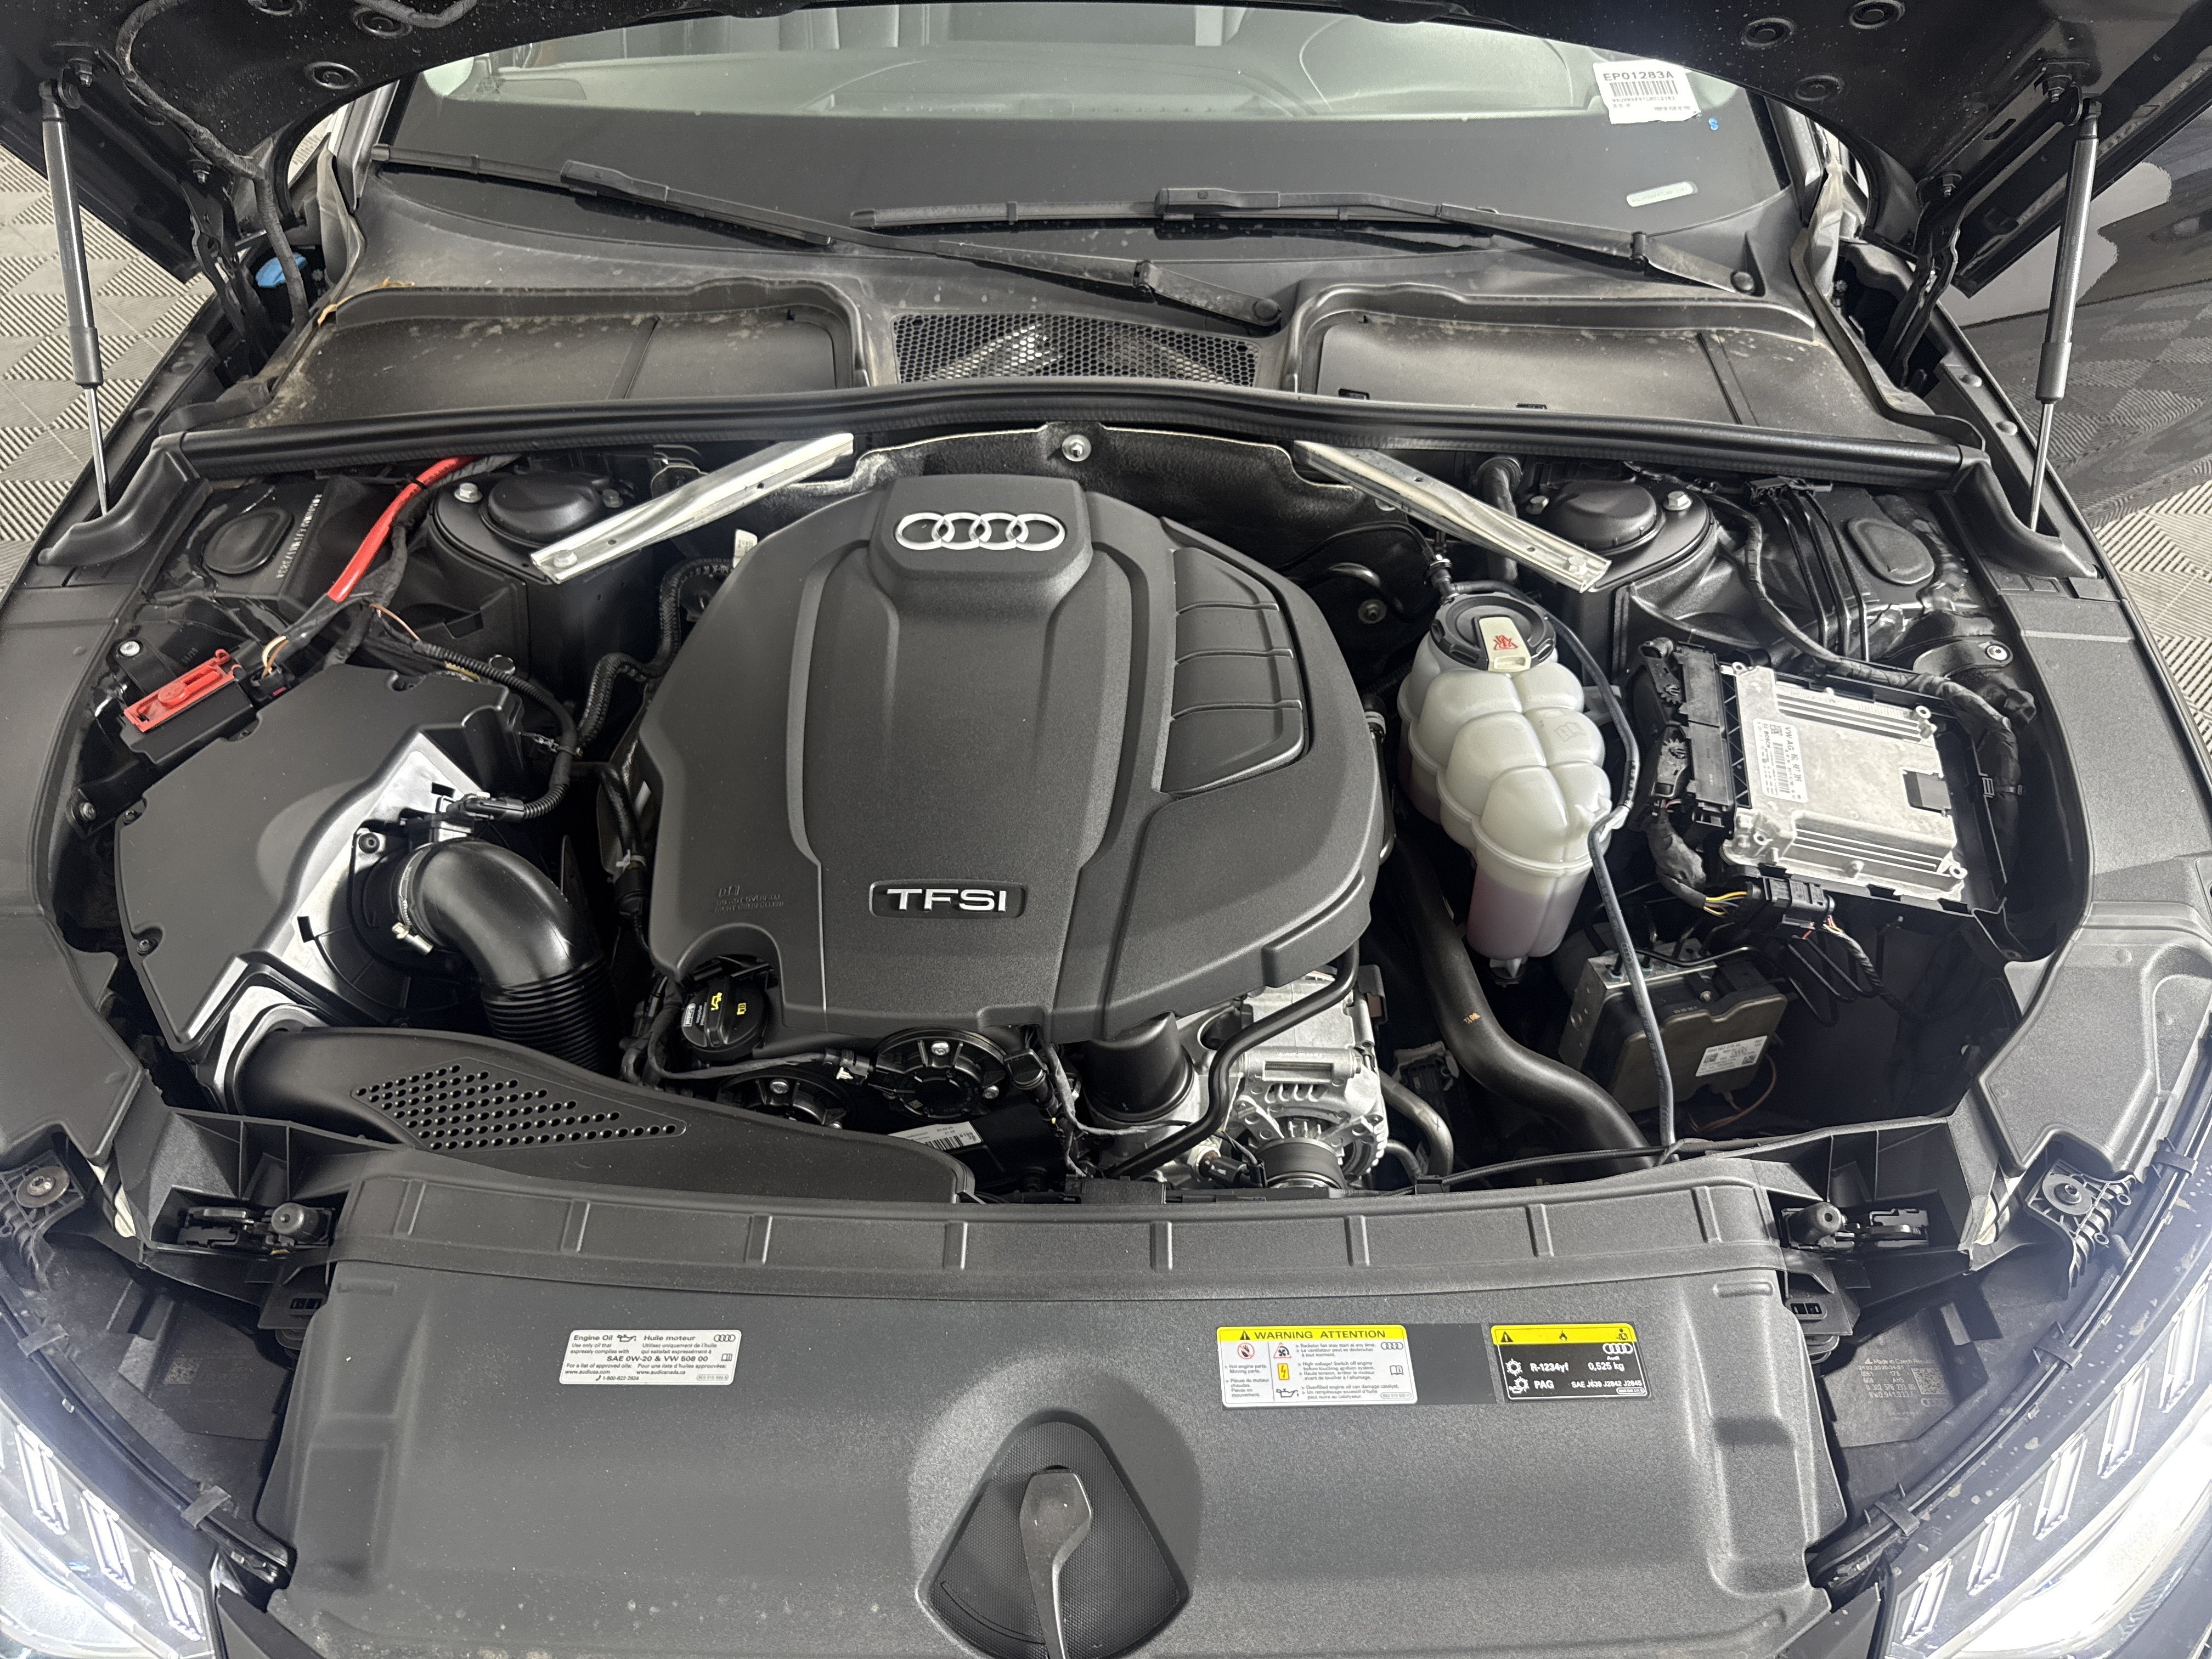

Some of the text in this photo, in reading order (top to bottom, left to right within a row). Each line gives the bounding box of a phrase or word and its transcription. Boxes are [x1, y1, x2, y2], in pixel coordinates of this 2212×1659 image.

[1602, 71, 1674, 81] EP01283A
[1785, 727, 1792, 738] VW
[1786, 740, 1795, 751] AG
[887, 888, 1007, 912] TFSI
[1254, 1330, 1386, 1339] WARNING ATTENTION
[1530, 1362, 1569, 1373] R-1234yf
[1613, 1361, 1625, 1372] kg
[1533, 1380, 1555, 1389] PAG
